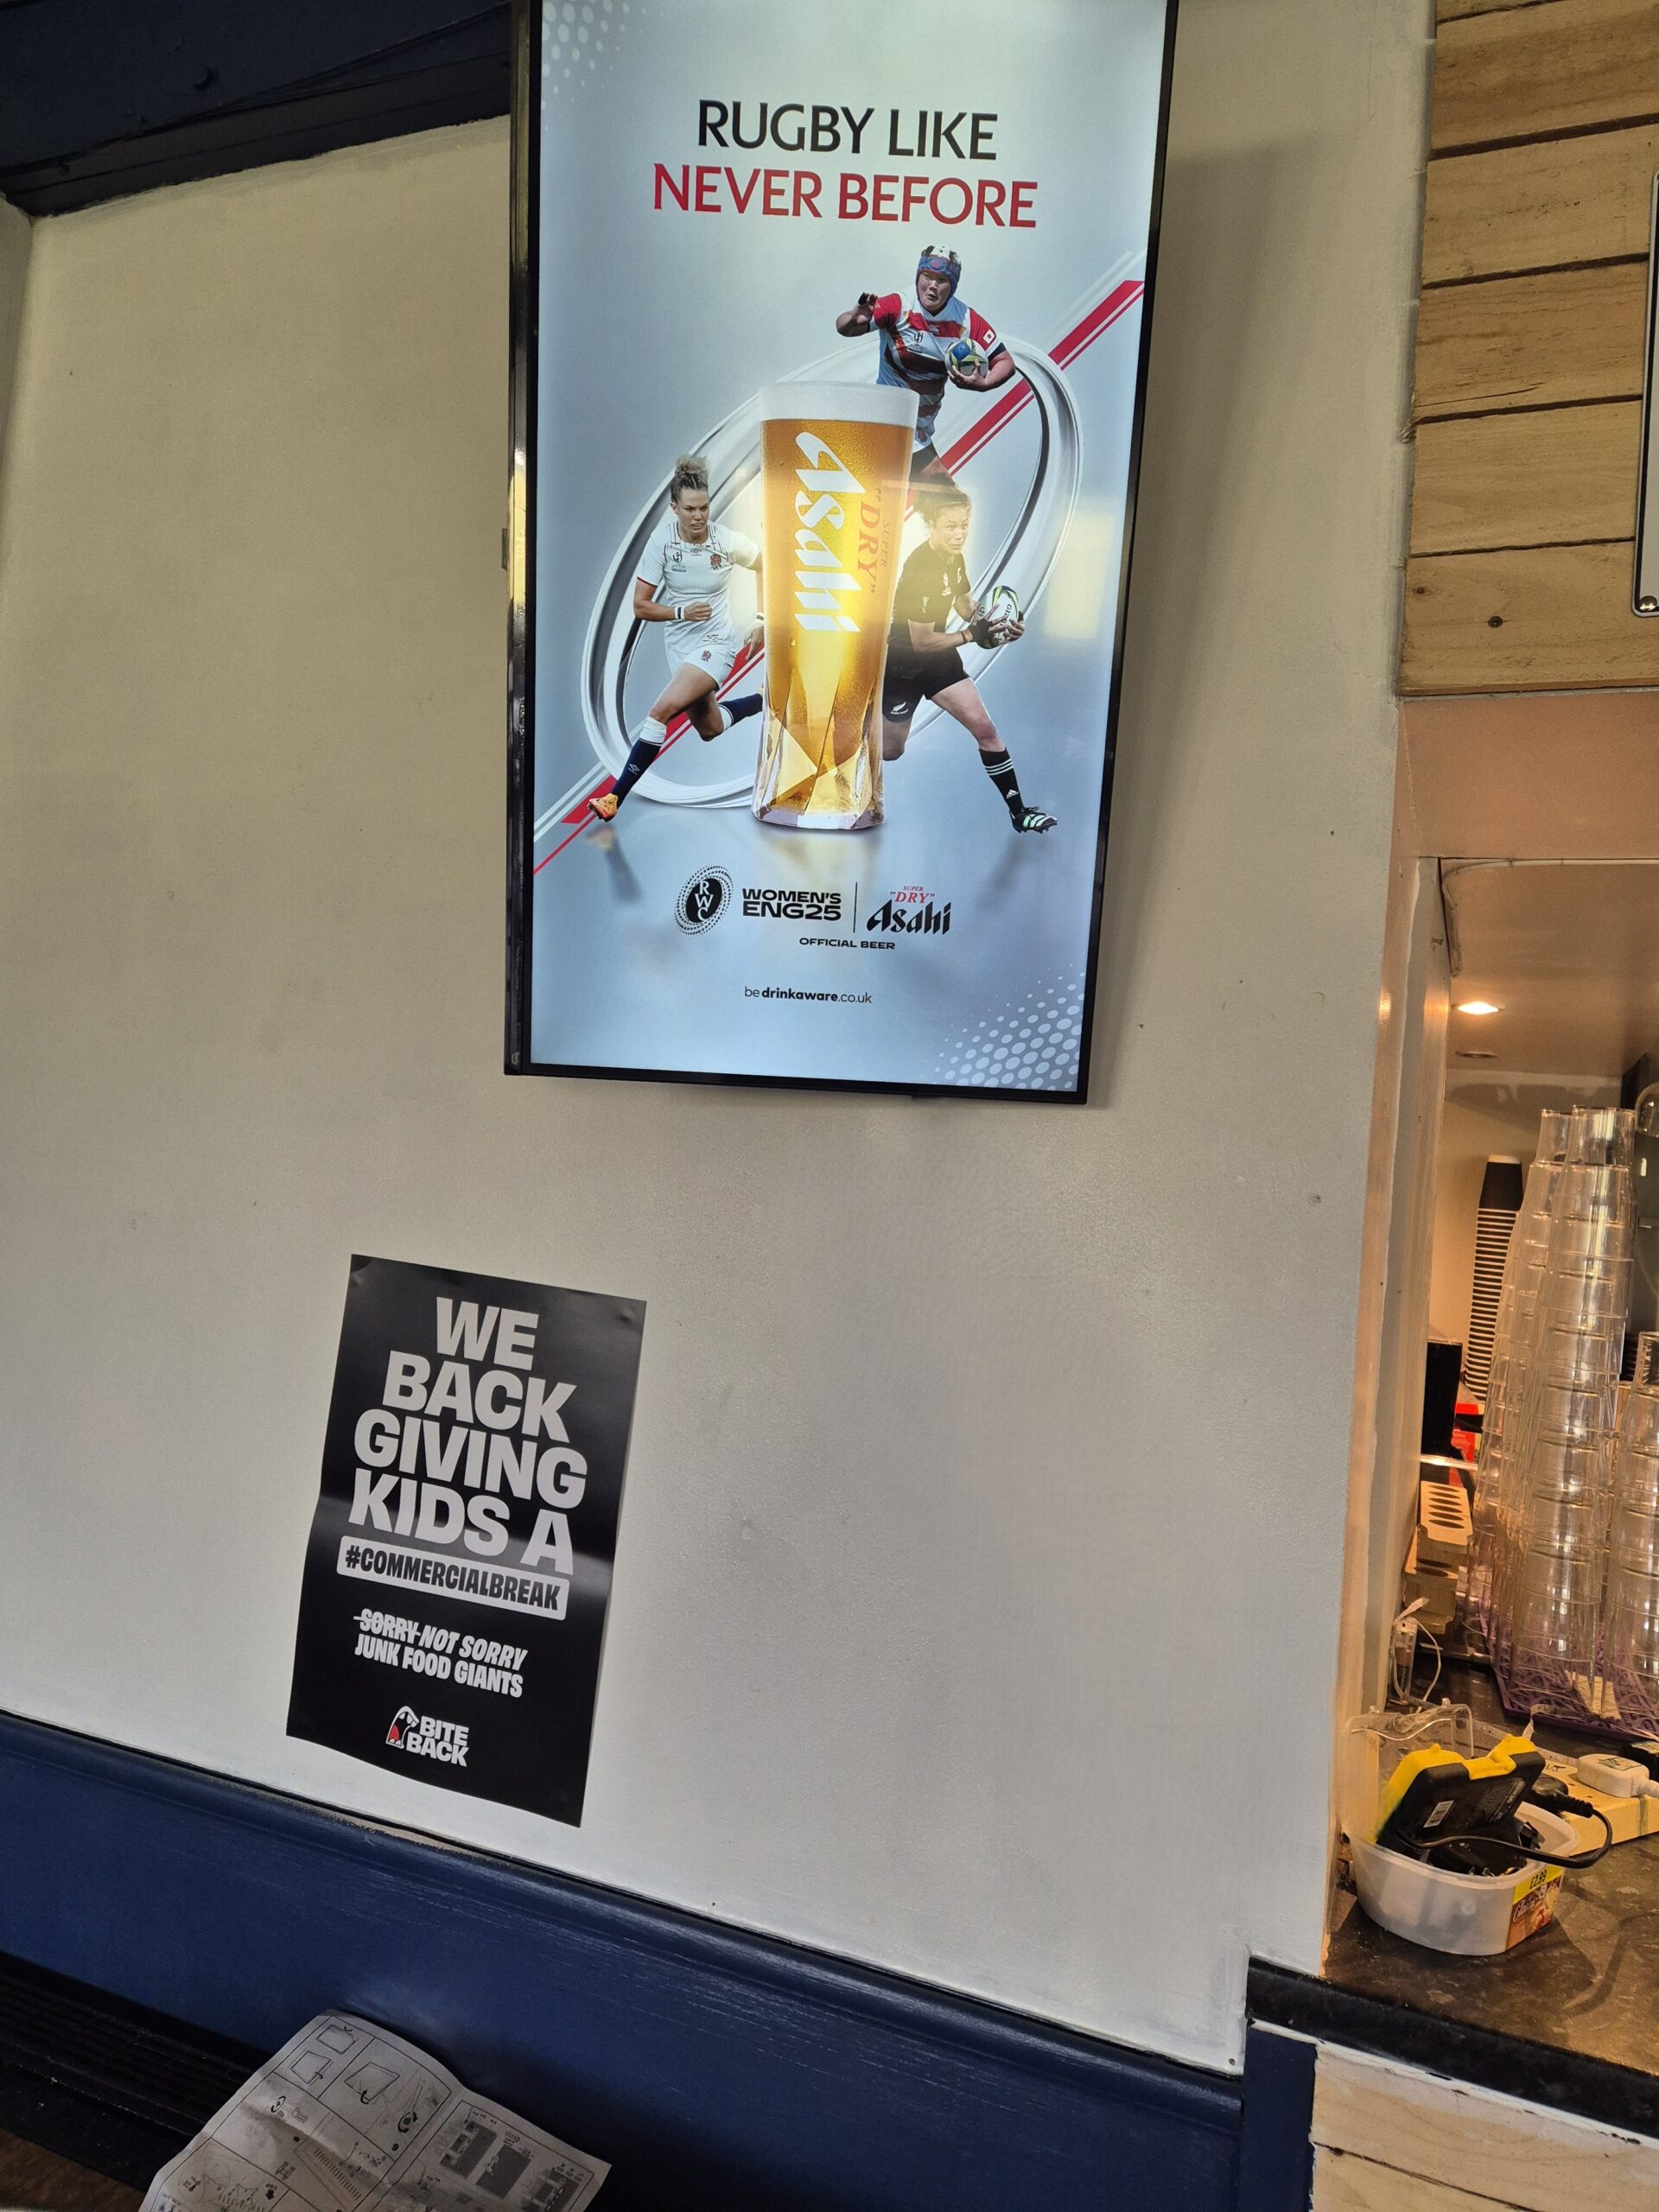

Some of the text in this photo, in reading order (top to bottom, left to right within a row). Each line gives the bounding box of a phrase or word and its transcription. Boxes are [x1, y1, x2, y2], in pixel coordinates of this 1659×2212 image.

[698, 99, 998, 161] RUGBY LIKE
[653, 163, 1038, 228] NEVER BEFORE
[794, 431, 867, 632] Asahi
[880, 519, 891, 568] SUPER
[742, 887, 842, 905] WOMEN'S
[742, 900, 842, 921] ENG25
[866, 899, 951, 935] Asahi
[799, 937, 895, 950] OFFICIAL BEER
[435, 1296, 539, 1370] WE
[382, 1350, 577, 1443] BACK
[353, 1408, 588, 1509] GIVING
[348, 1468, 574, 1575] KIDS A
[345, 1545, 561, 1611] #COMMERCIALBREAK
[354, 1633, 524, 1699] JUNK FOOD GIANTS
[356, 1608, 528, 1671] SORRY NOT SORRY
[406, 1731, 470, 1768] BACK
[419, 1715, 470, 1746] BITE
